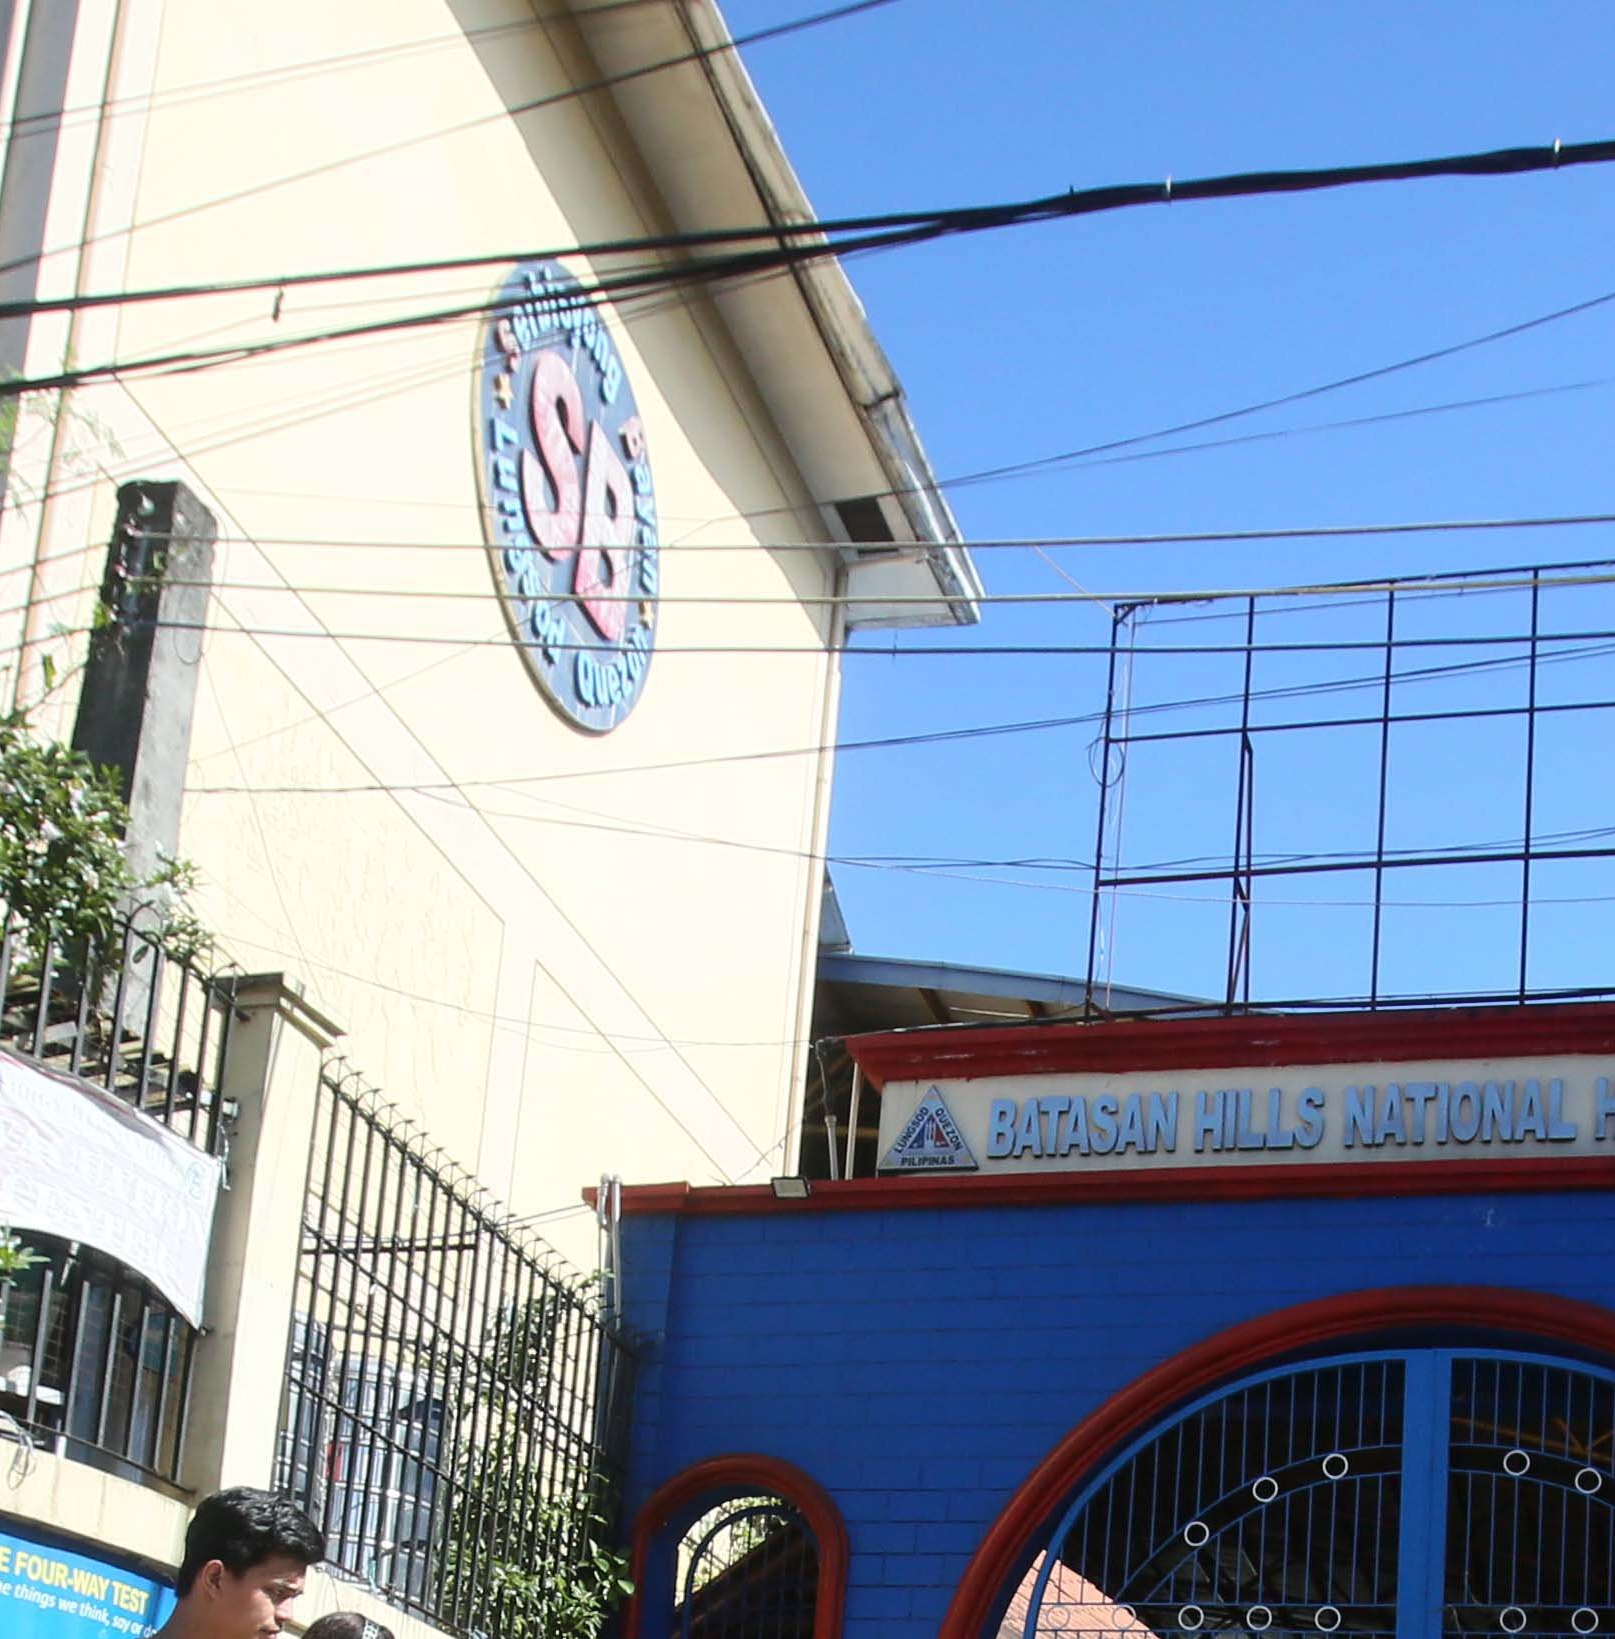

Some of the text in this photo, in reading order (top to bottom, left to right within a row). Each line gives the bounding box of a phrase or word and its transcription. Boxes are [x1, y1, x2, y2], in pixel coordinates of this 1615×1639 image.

[618, 415, 659, 595] Bayan
[491, 417, 648, 709] Lungsod Quezon
[894, 1106, 962, 1153] LUNGSOD QUEZON
[987, 1089, 1178, 1159] BATASAN
[1195, 1086, 1325, 1153] HILLS
[1344, 1077, 1578, 1148] NATIONAL
[901, 1155, 955, 1167] PILIPINAS
[14, 1551, 111, 1601] FOUR-WAY
[111, 1580, 149, 1616] TEST
[15, 1583, 56, 1610] things
[58, 1597, 78, 1613] we
[79, 1602, 111, 1627] think,
[112, 1614, 130, 1634] say
[131, 1623, 144, 1636] or
